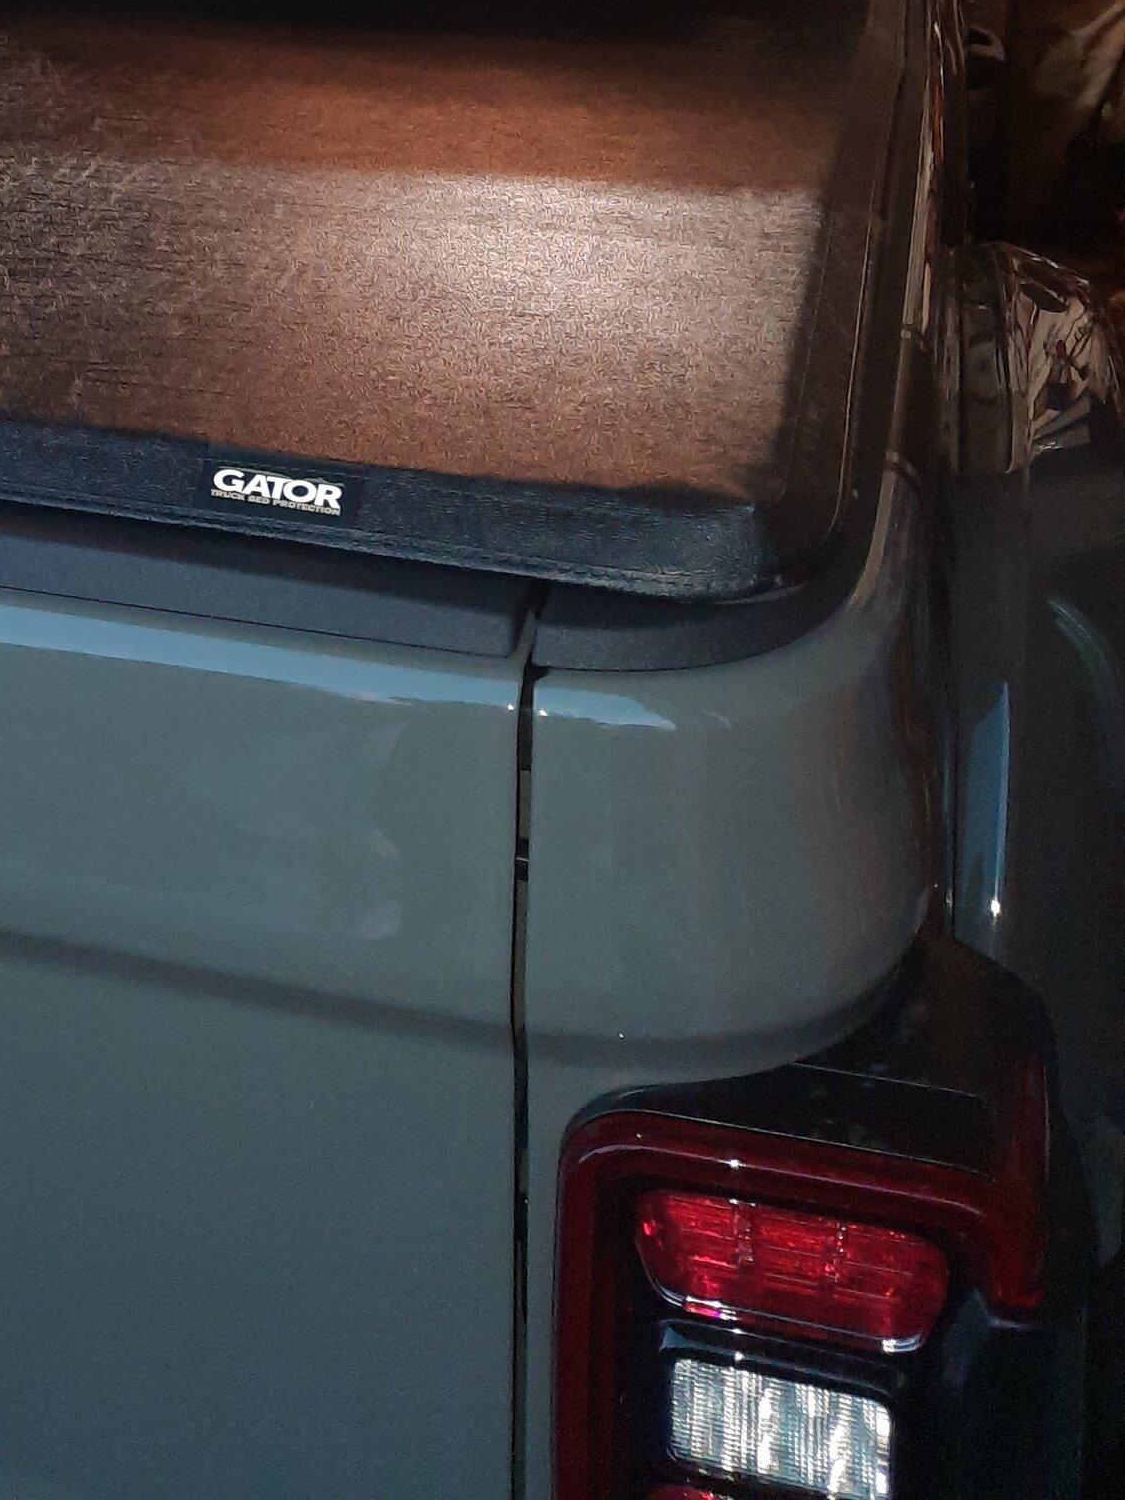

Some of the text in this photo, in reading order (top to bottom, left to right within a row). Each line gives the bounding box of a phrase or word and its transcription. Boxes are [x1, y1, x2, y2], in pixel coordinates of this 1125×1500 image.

[211, 488, 342, 517] TRUCK BED PROTECTION
[213, 469, 342, 509] GATOR
